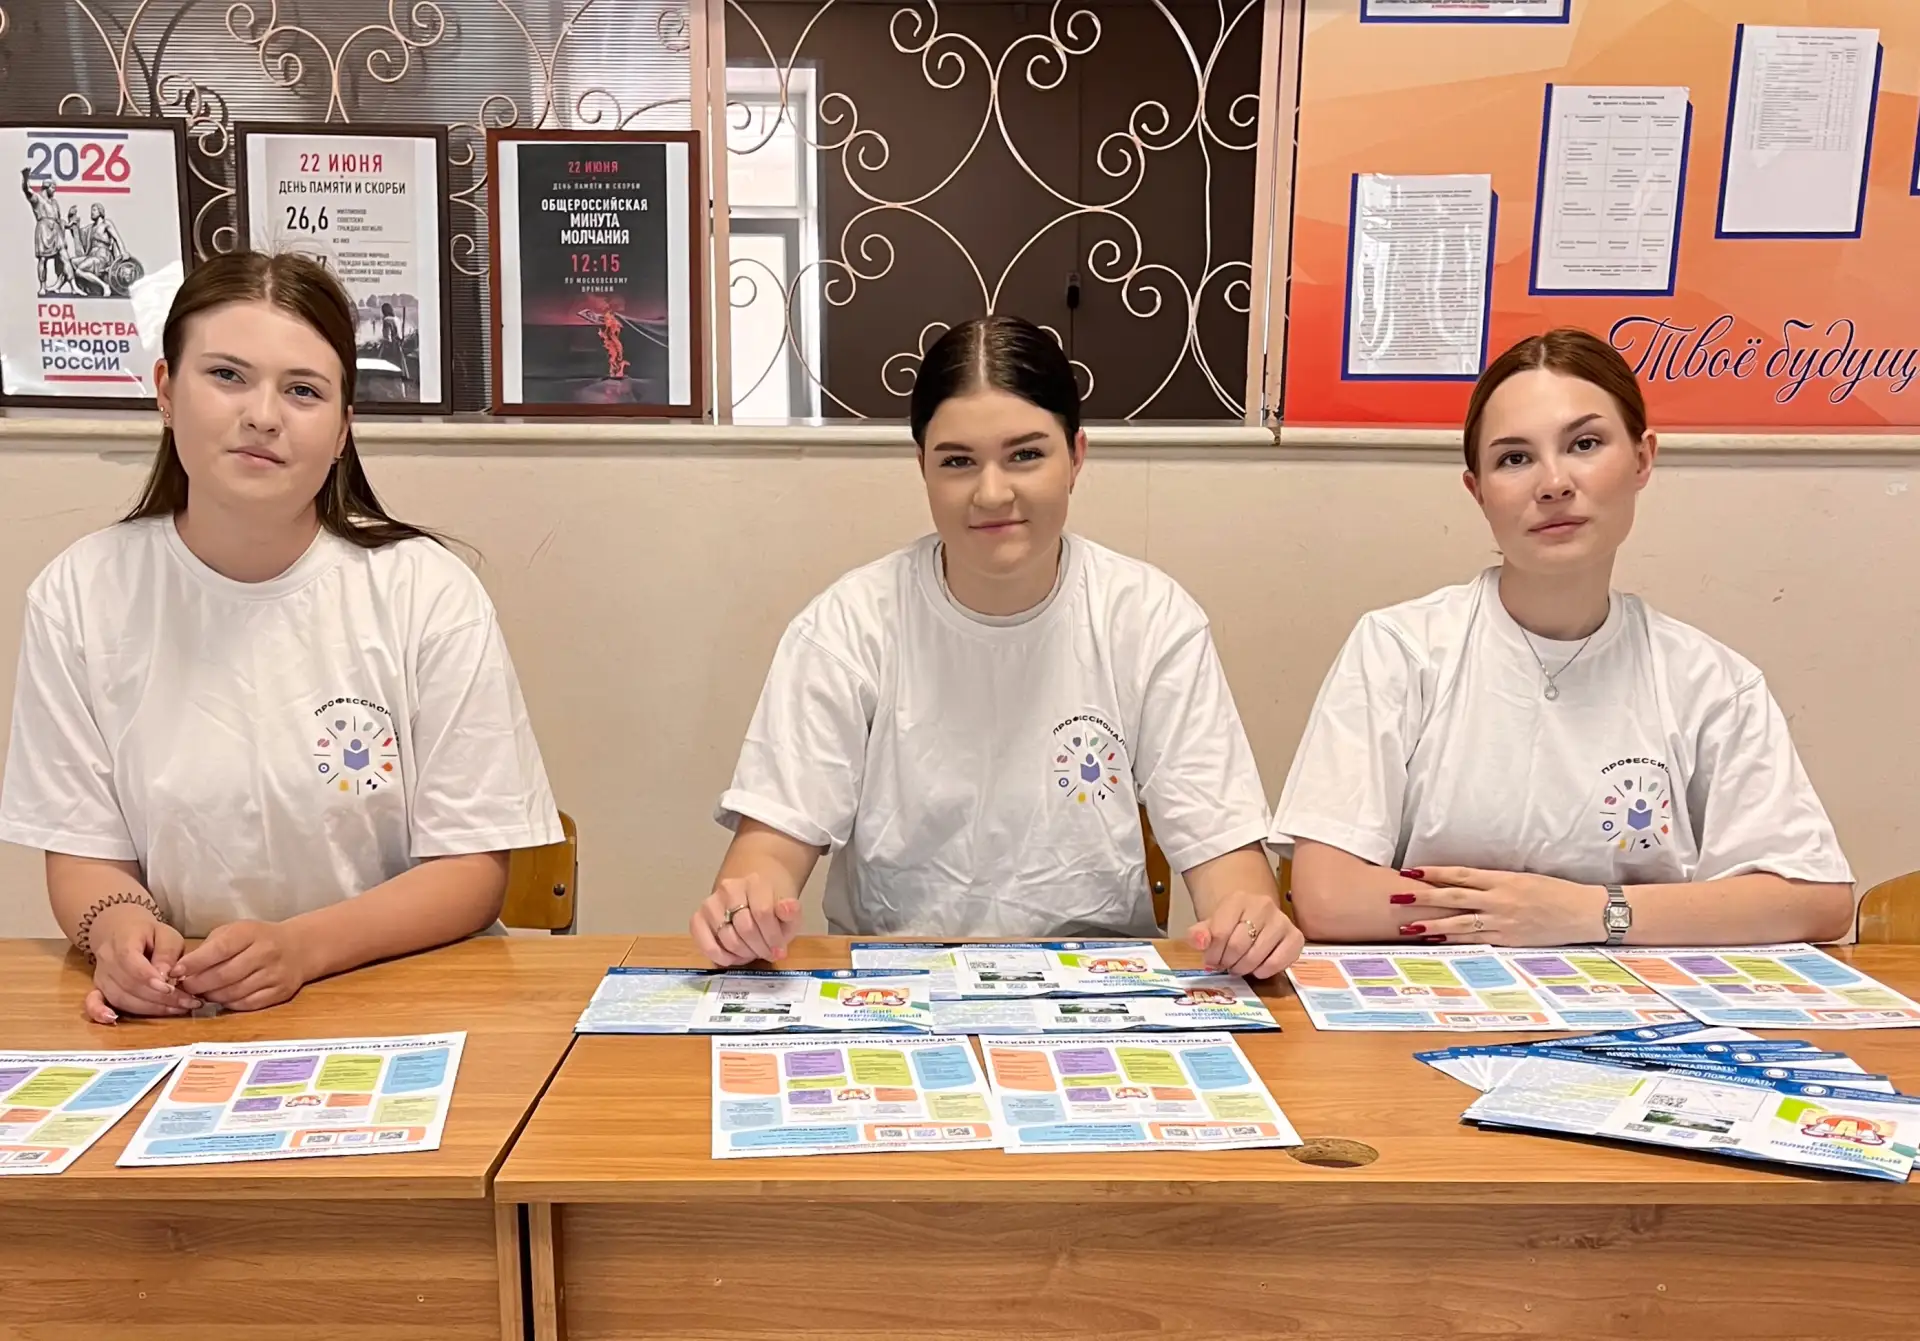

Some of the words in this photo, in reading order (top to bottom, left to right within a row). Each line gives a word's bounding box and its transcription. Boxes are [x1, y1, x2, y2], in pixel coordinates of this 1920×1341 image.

[27, 142, 131, 182] 2026
[300, 153, 321, 172] 22
[328, 154, 383, 173] ИЮНЯ
[568, 161, 581, 174] 22
[585, 160, 619, 173] ИЮНЯ
[278, 180, 307, 196] ДЕНЬ
[309, 181, 352, 194] ПАМЯТИ
[355, 182, 362, 195] И
[364, 181, 406, 195] СКОРБИ
[574, 182, 603, 191] ПАМЯТИ
[612, 182, 641, 191] СКОРБИ
[541, 196, 648, 214] ОБЩЕРОССИЙСКАЯ
[286, 205, 329, 234] 26,6
[570, 213, 620, 228] МИНУТА
[561, 229, 630, 245] МОЛЧАНИЯ
[571, 253, 621, 273] 12:15
[37, 303, 75, 320] ГОД
[39, 321, 139, 337] ЕДИНСТВА
[41, 338, 130, 354] НАРОДОВ
[1608, 314, 1762, 382] Твоё
[43, 355, 120, 371] РОССИИ
[1667, 1067, 1702, 1076] ДОБРО
[1703, 1071, 1777, 1087] ПОЖАЛОВАТЬ!
